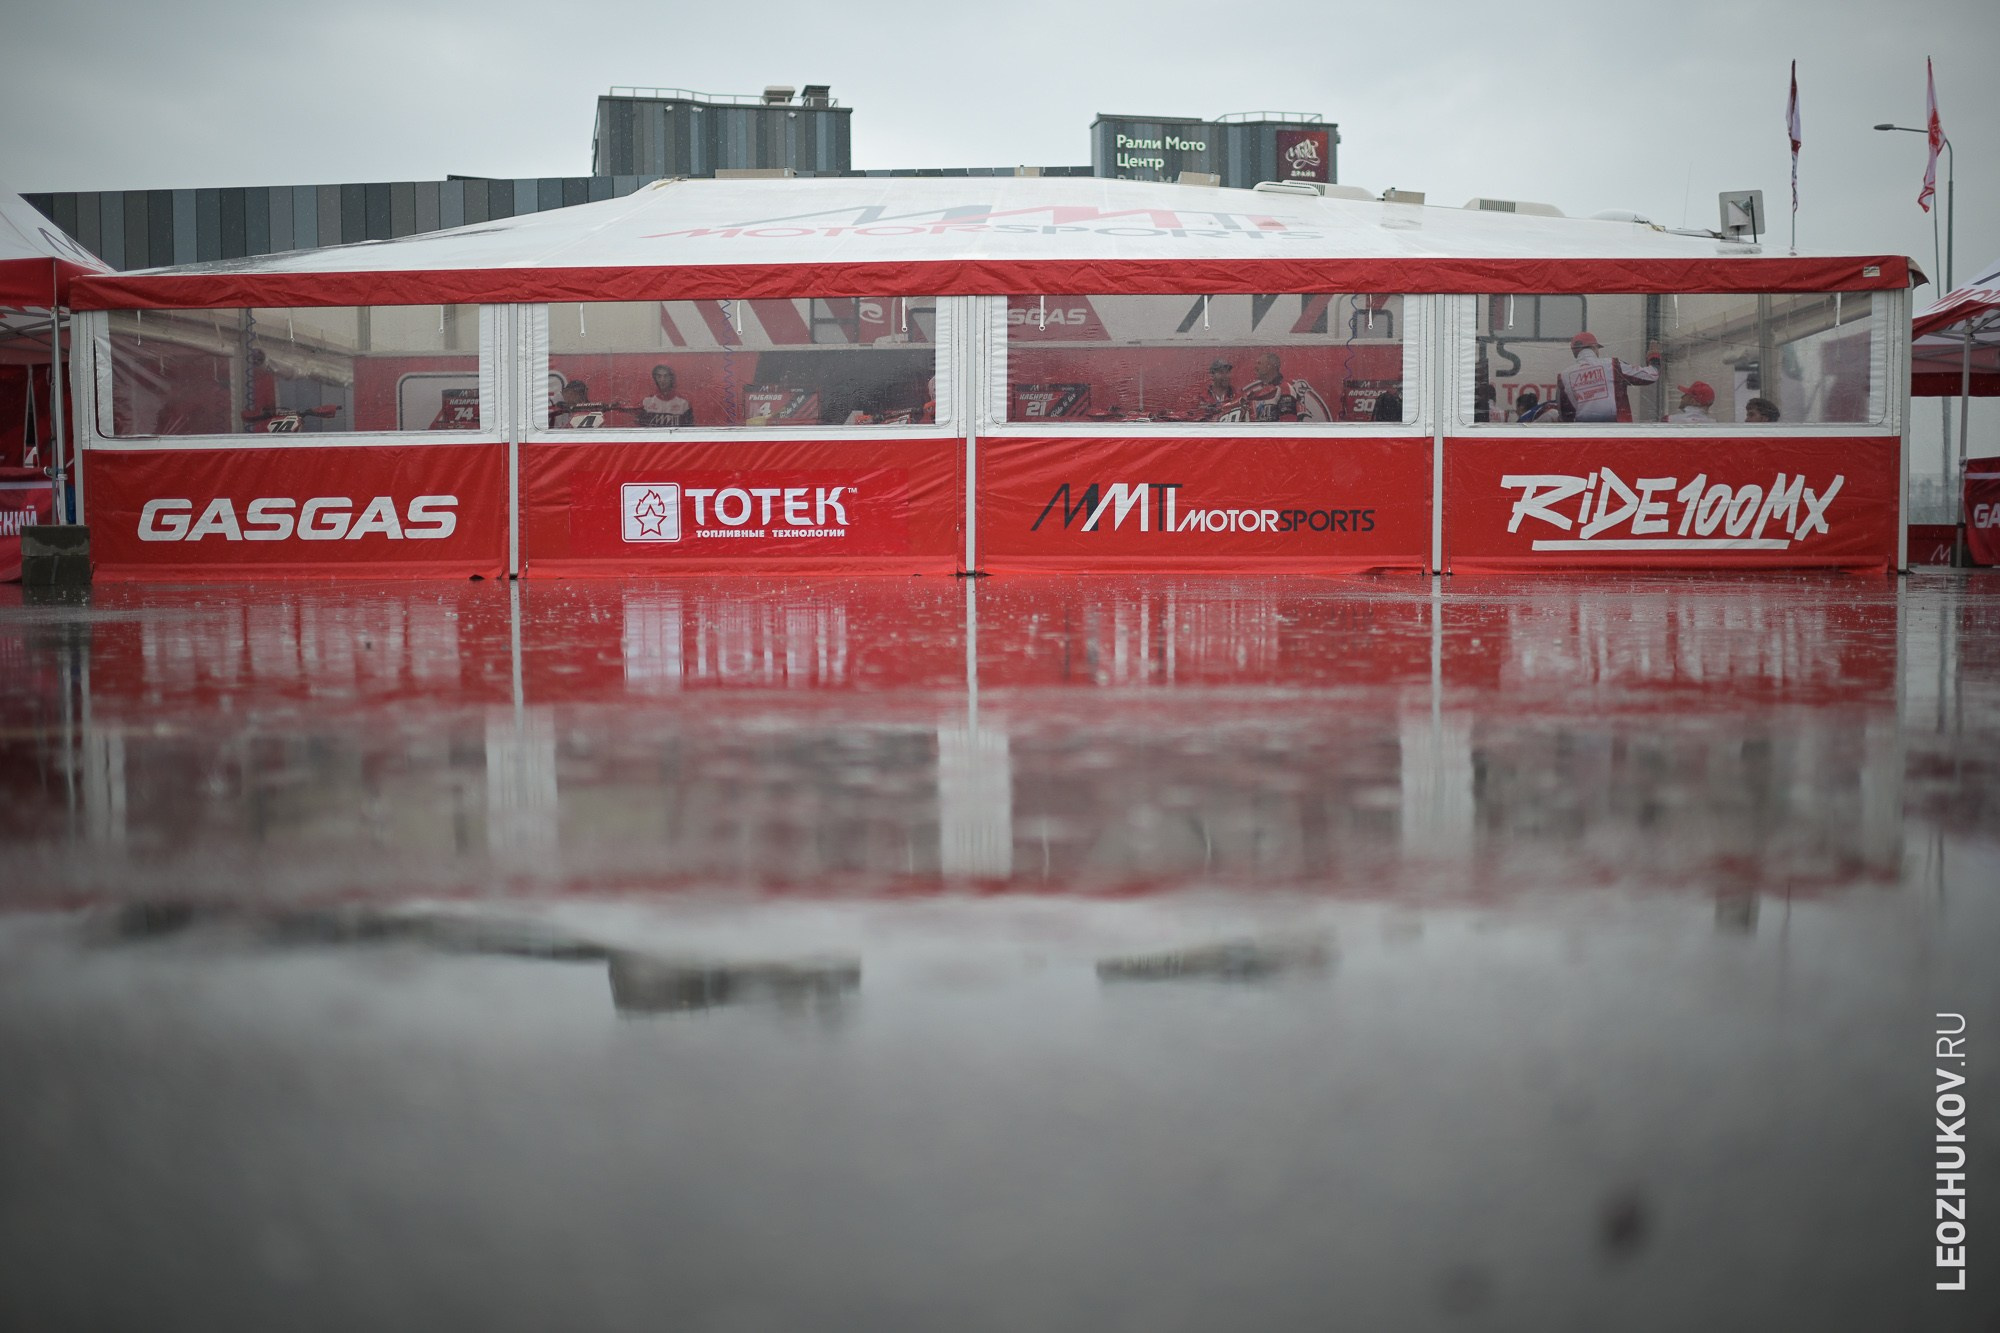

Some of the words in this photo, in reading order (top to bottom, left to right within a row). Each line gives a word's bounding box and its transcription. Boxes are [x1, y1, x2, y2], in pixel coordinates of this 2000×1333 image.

[1116, 134, 1162, 149] Ралли
[1165, 136, 1206, 151] Мото
[1116, 153, 1165, 171] Центр
[760, 402, 771, 417] 4
[1025, 402, 1047, 417] 21
[1353, 398, 1377, 412] 30
[454, 407, 474, 421] 74
[137, 495, 459, 541] GASGAS
[1177, 509, 1375, 532] MOTORSPORTS
[696, 529, 765, 538] ТОПЛИВНЫЕ
[772, 529, 845, 538] ТЕХНОЛОГИИ
